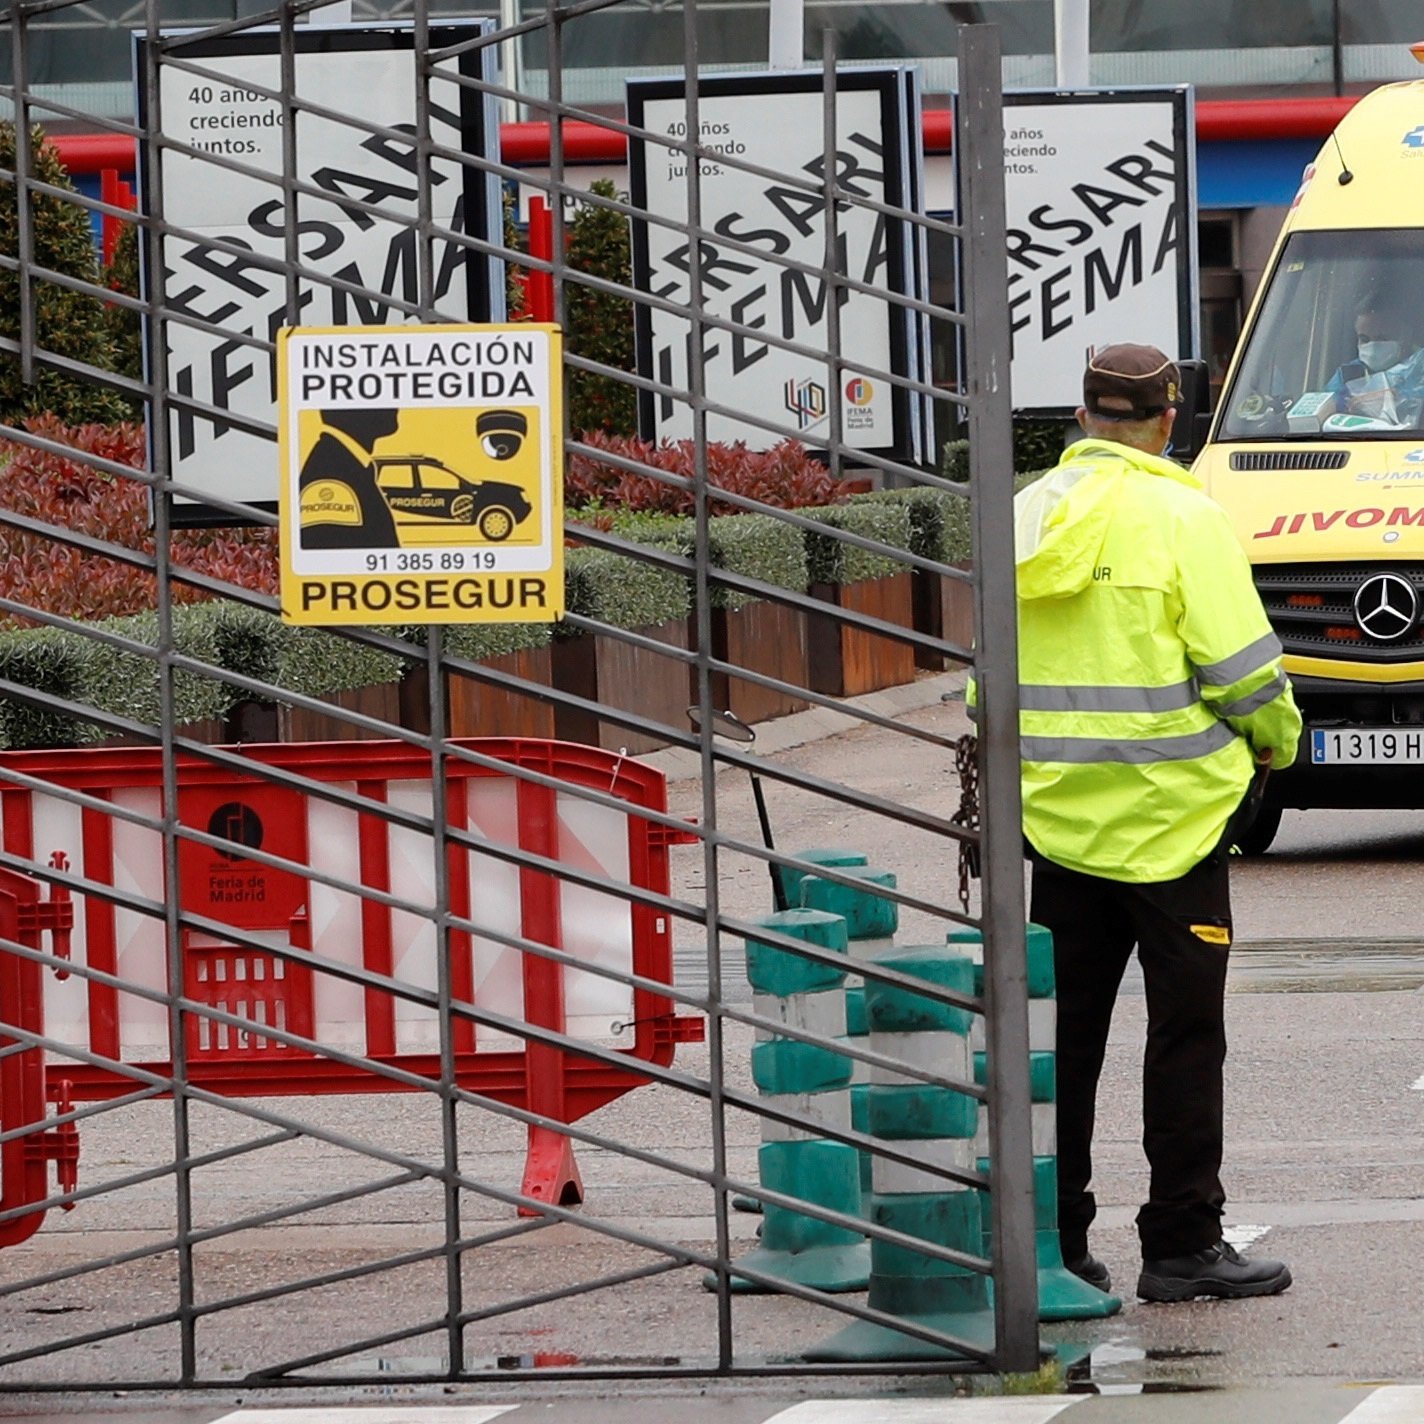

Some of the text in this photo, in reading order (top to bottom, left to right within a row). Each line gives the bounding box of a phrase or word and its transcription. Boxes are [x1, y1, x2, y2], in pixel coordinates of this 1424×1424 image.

[188, 86, 214, 104] 40
[667, 122, 686, 137] 40
[1010, 128, 1044, 140] años
[303, 334, 534, 368] INSTALACIÓN
[303, 371, 535, 401] PROTEGIDA
[300, 502, 355, 514] PROSEGUR
[390, 496, 445, 508] PROSEGUR
[365, 552, 496, 571] 91 385 89 19
[302, 577, 546, 612] PROSEGUR
[1333, 733, 1397, 759] 1319
[209, 876, 265, 888] Feria de
[209, 889, 265, 902] Madrid
